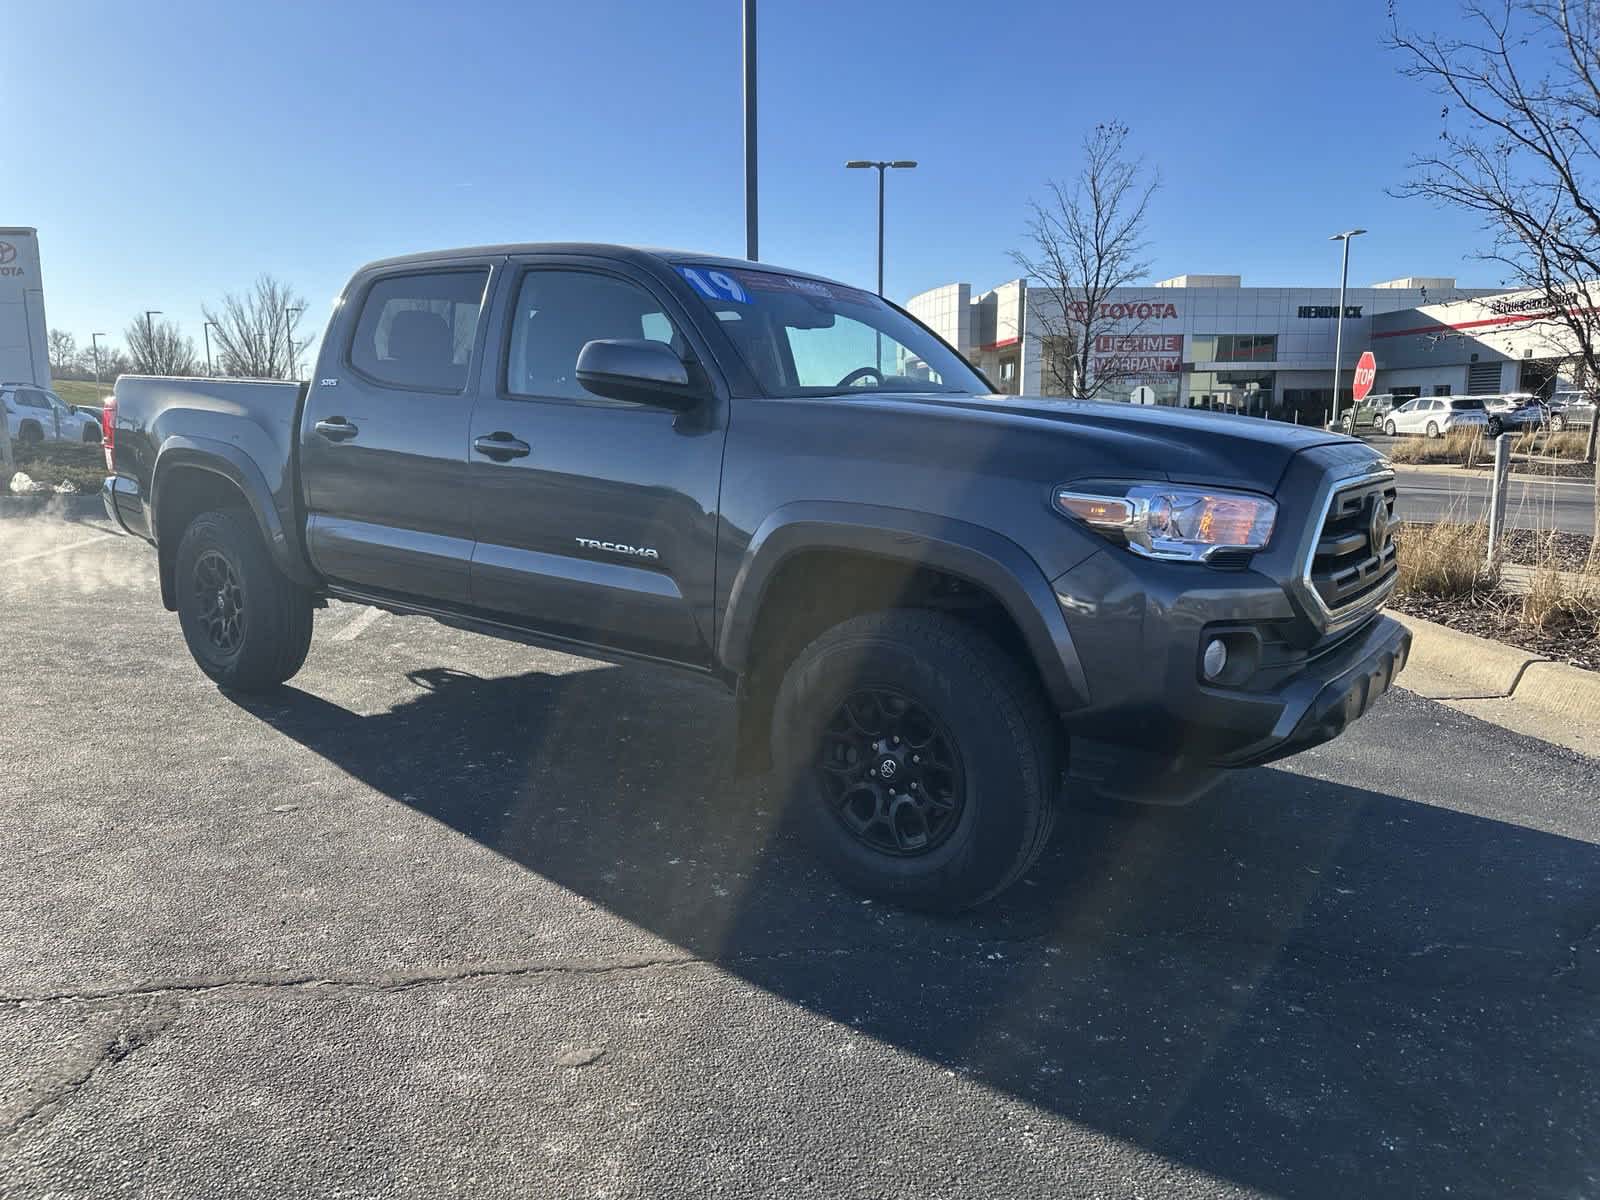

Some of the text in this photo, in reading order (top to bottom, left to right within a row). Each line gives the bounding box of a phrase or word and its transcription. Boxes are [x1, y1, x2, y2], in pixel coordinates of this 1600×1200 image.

[1100, 303, 1178, 320] TOYOTA
[1298, 306, 1363, 318] HENDRCK
[1100, 336, 1175, 351] LIFETIME
[1095, 357, 1179, 371] WARRANTY
[1354, 368, 1374, 385] STOP
[575, 537, 660, 560] TACOMA
